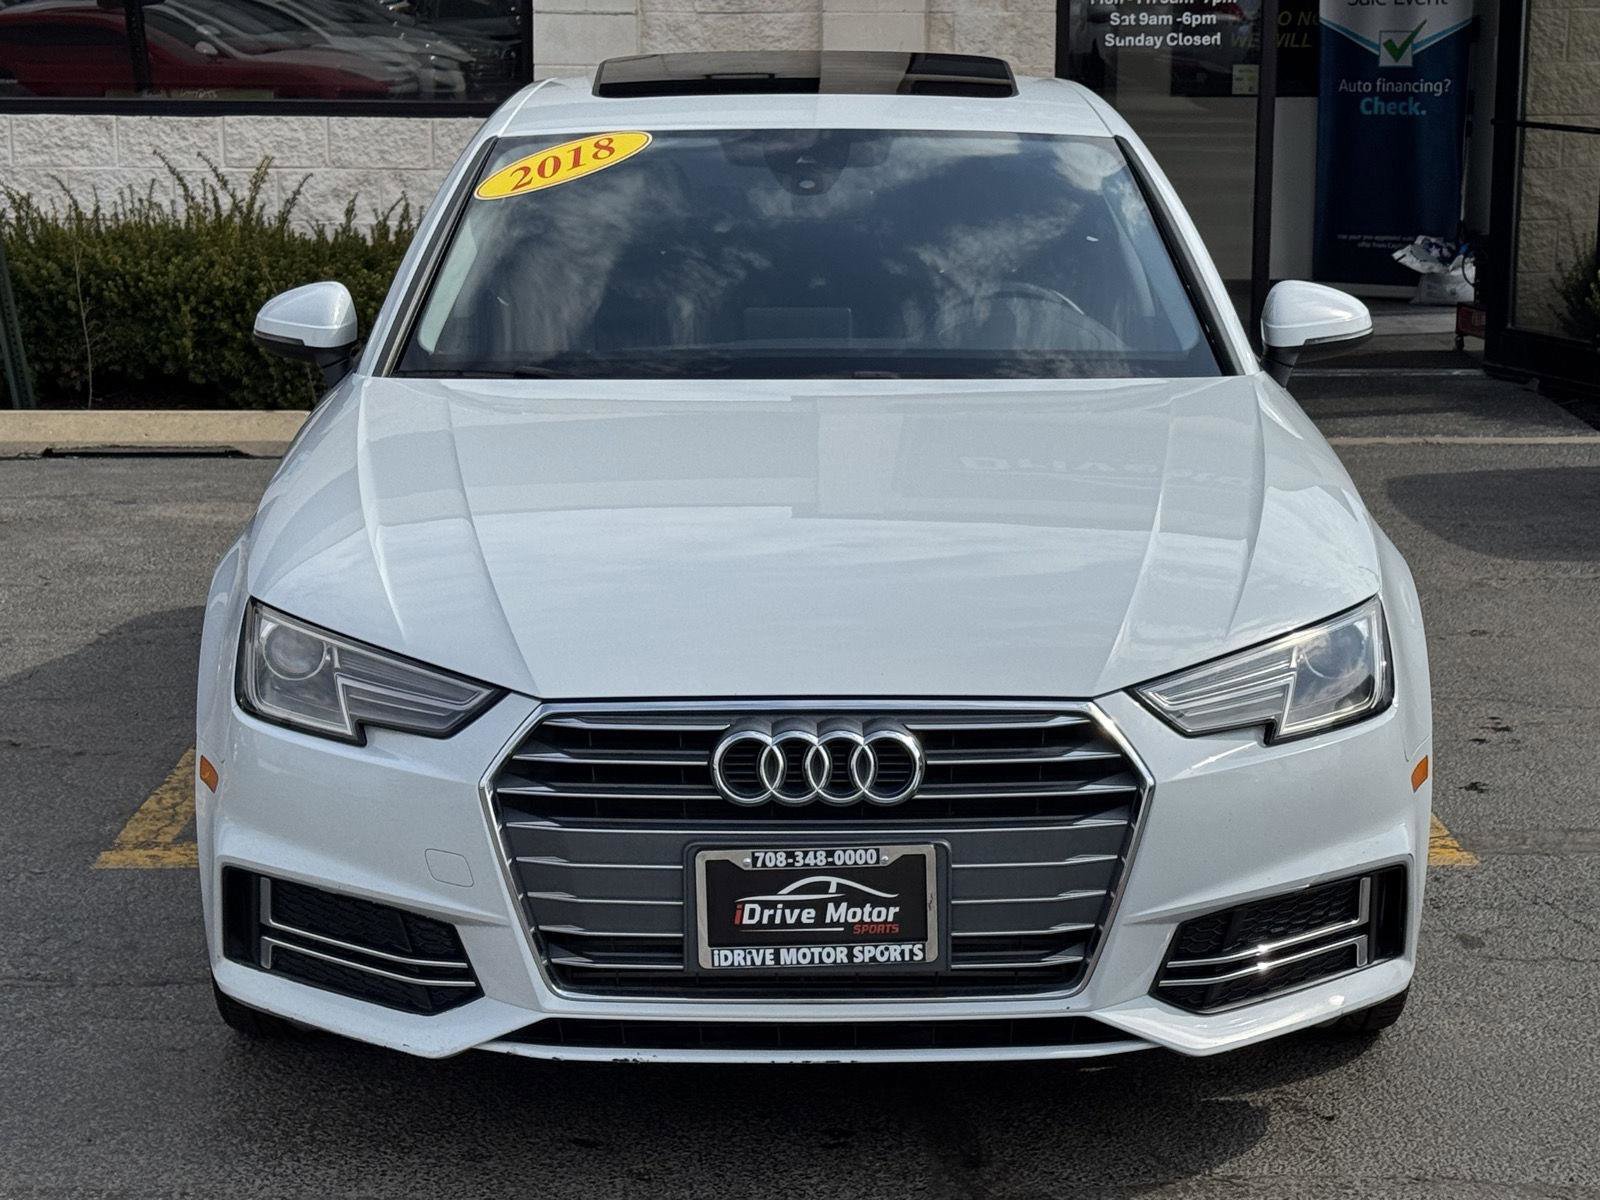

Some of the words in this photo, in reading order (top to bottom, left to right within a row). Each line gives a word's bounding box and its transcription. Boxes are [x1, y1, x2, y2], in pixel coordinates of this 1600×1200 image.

[1110, 12, 1136, 26] Sat
[1139, 12, 1173, 26] 9am
[1105, 33, 1163, 49] Sunday
[1166, 32, 1221, 46] Closed
[1338, 78, 1372, 93] Auto
[1376, 77, 1452, 97] financing?
[1359, 96, 1427, 116] Check.
[510, 137, 615, 191] 2018
[754, 849, 878, 868] 708-348-0000
[734, 902, 815, 925] iDrive
[825, 901, 900, 924] Motor
[852, 923, 900, 935] SPORTS
[780, 946, 848, 965] MOTOR
[852, 944, 924, 962] SPORTS
